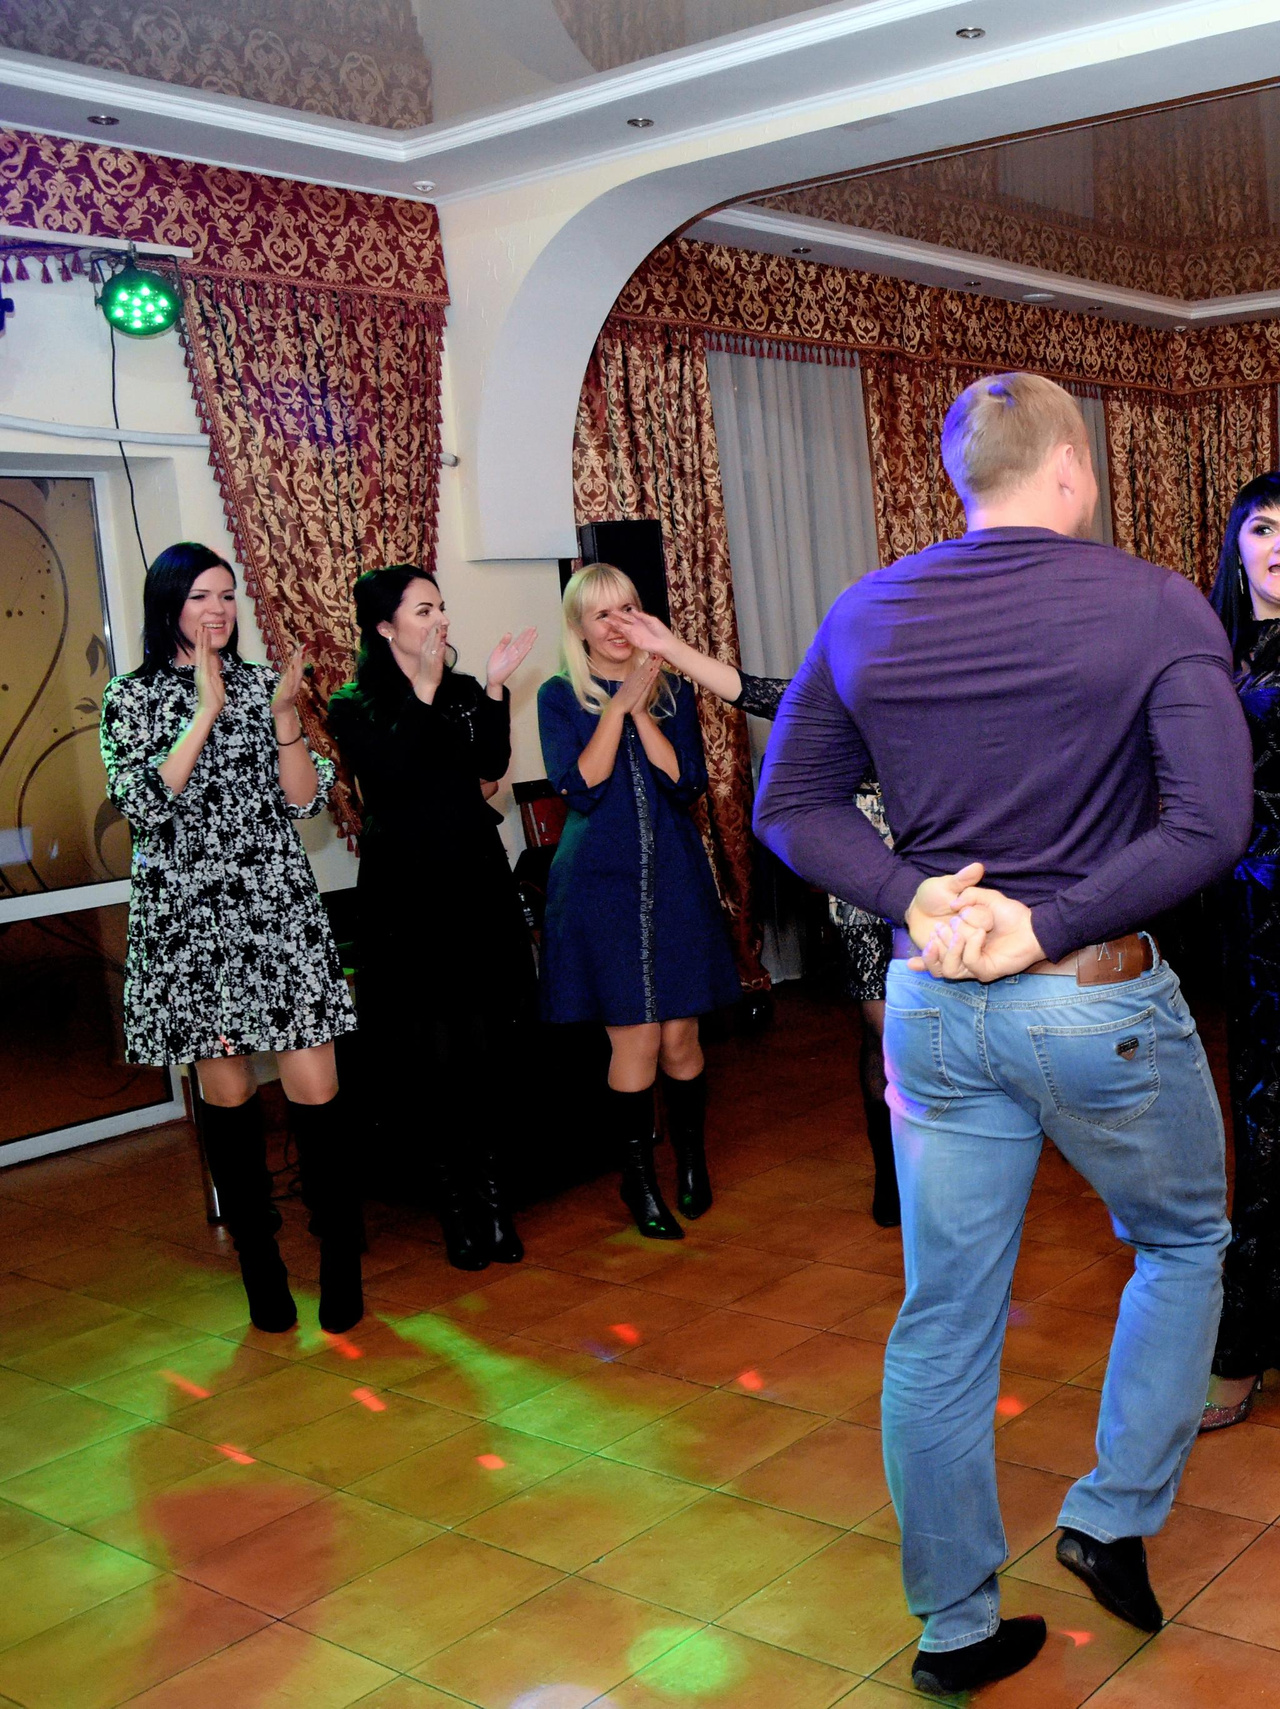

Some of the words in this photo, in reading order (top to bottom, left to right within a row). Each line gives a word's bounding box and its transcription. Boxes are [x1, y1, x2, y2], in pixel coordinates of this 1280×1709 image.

[640, 949, 649, 959] feel
[642, 963, 649, 973] me
[642, 974, 651, 986] with
